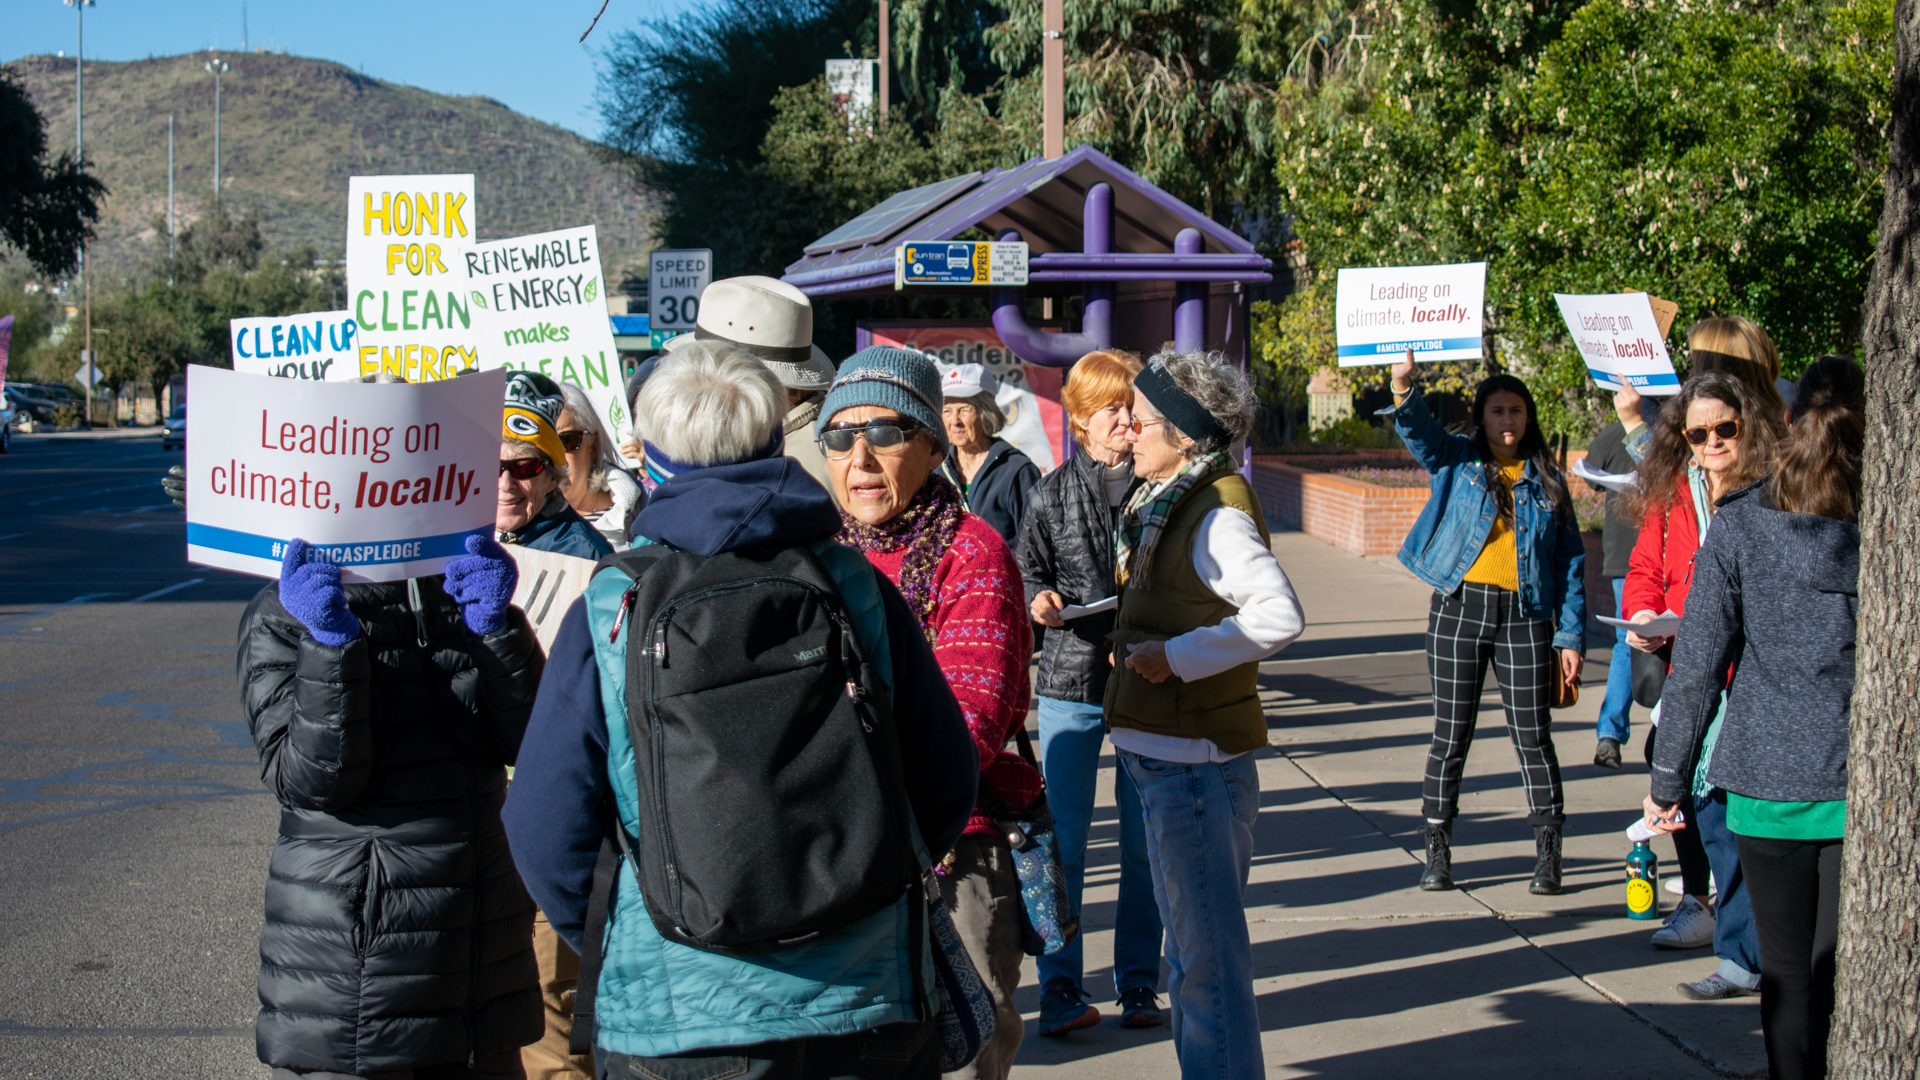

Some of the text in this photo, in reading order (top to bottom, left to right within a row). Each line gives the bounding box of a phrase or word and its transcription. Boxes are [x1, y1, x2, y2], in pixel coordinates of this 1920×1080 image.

[364, 191, 468, 237] HONK
[387, 243, 448, 275] FOR
[465, 237, 591, 278] RENEWABLE
[655, 260, 706, 272] SPEED
[977, 245, 988, 281] EXPRESS
[493, 273, 583, 312] ENERGY
[660, 276, 699, 288] LIMIT
[1371, 282, 1451, 302] Leading on
[356, 289, 470, 331] CLEAN
[659, 295, 699, 324] 30
[1347, 304, 1471, 328] climate, locally.
[1577, 311, 1633, 335] Leading on
[237, 318, 356, 358] CLEAN UP
[504, 322, 570, 346] makes
[1612, 338, 1659, 360] locally.
[359, 344, 479, 383] ENERGY
[502, 351, 609, 390] EAN
[261, 409, 440, 463] Leading on
[211, 459, 481, 514] climate, locally.
[271, 541, 422, 563] #ERICASPLEDGE
